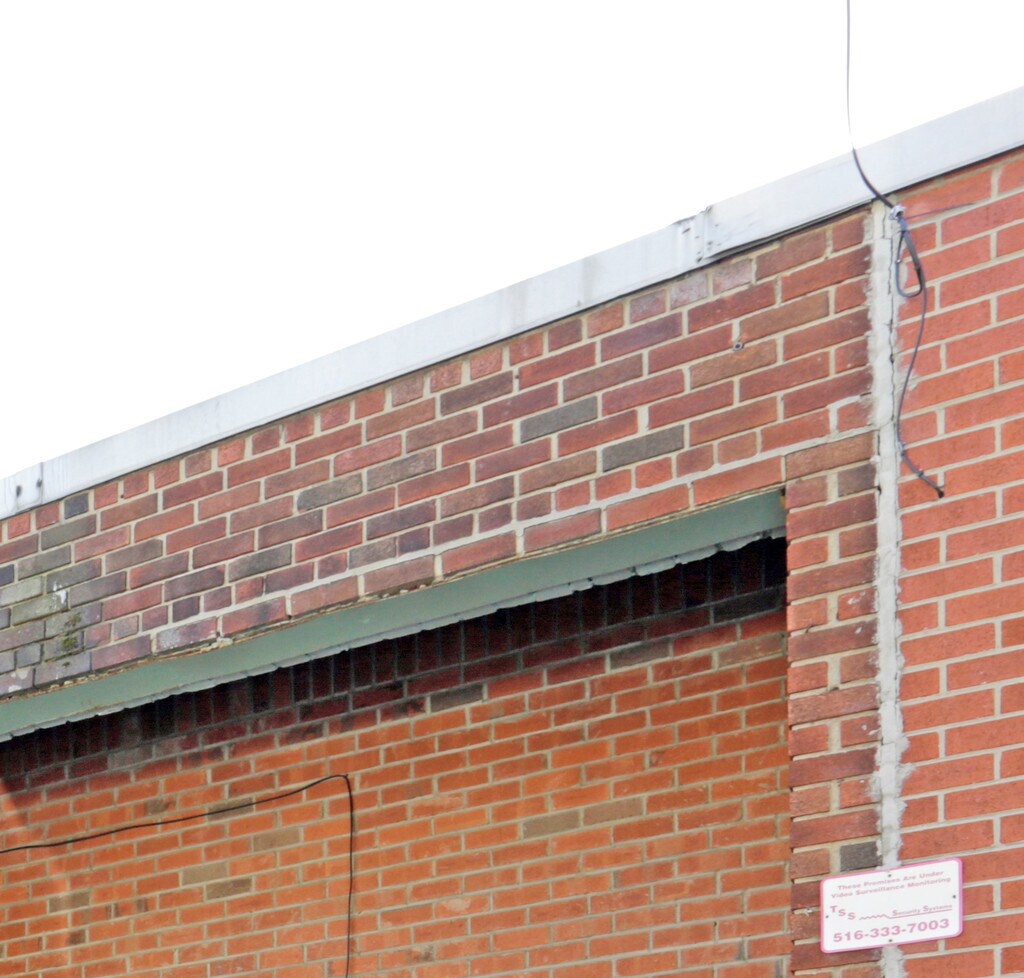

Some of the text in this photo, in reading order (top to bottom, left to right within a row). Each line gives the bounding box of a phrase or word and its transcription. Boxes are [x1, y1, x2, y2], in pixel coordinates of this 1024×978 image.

[831, 891, 854, 899] Video
[907, 876, 951, 888] Monitoring
[837, 882, 861, 891] These
[864, 877, 900, 886] Premises
[919, 870, 944, 879] Under
[892, 903, 952, 916] Security Systems
[833, 918, 950, 943] 516-333-7003
